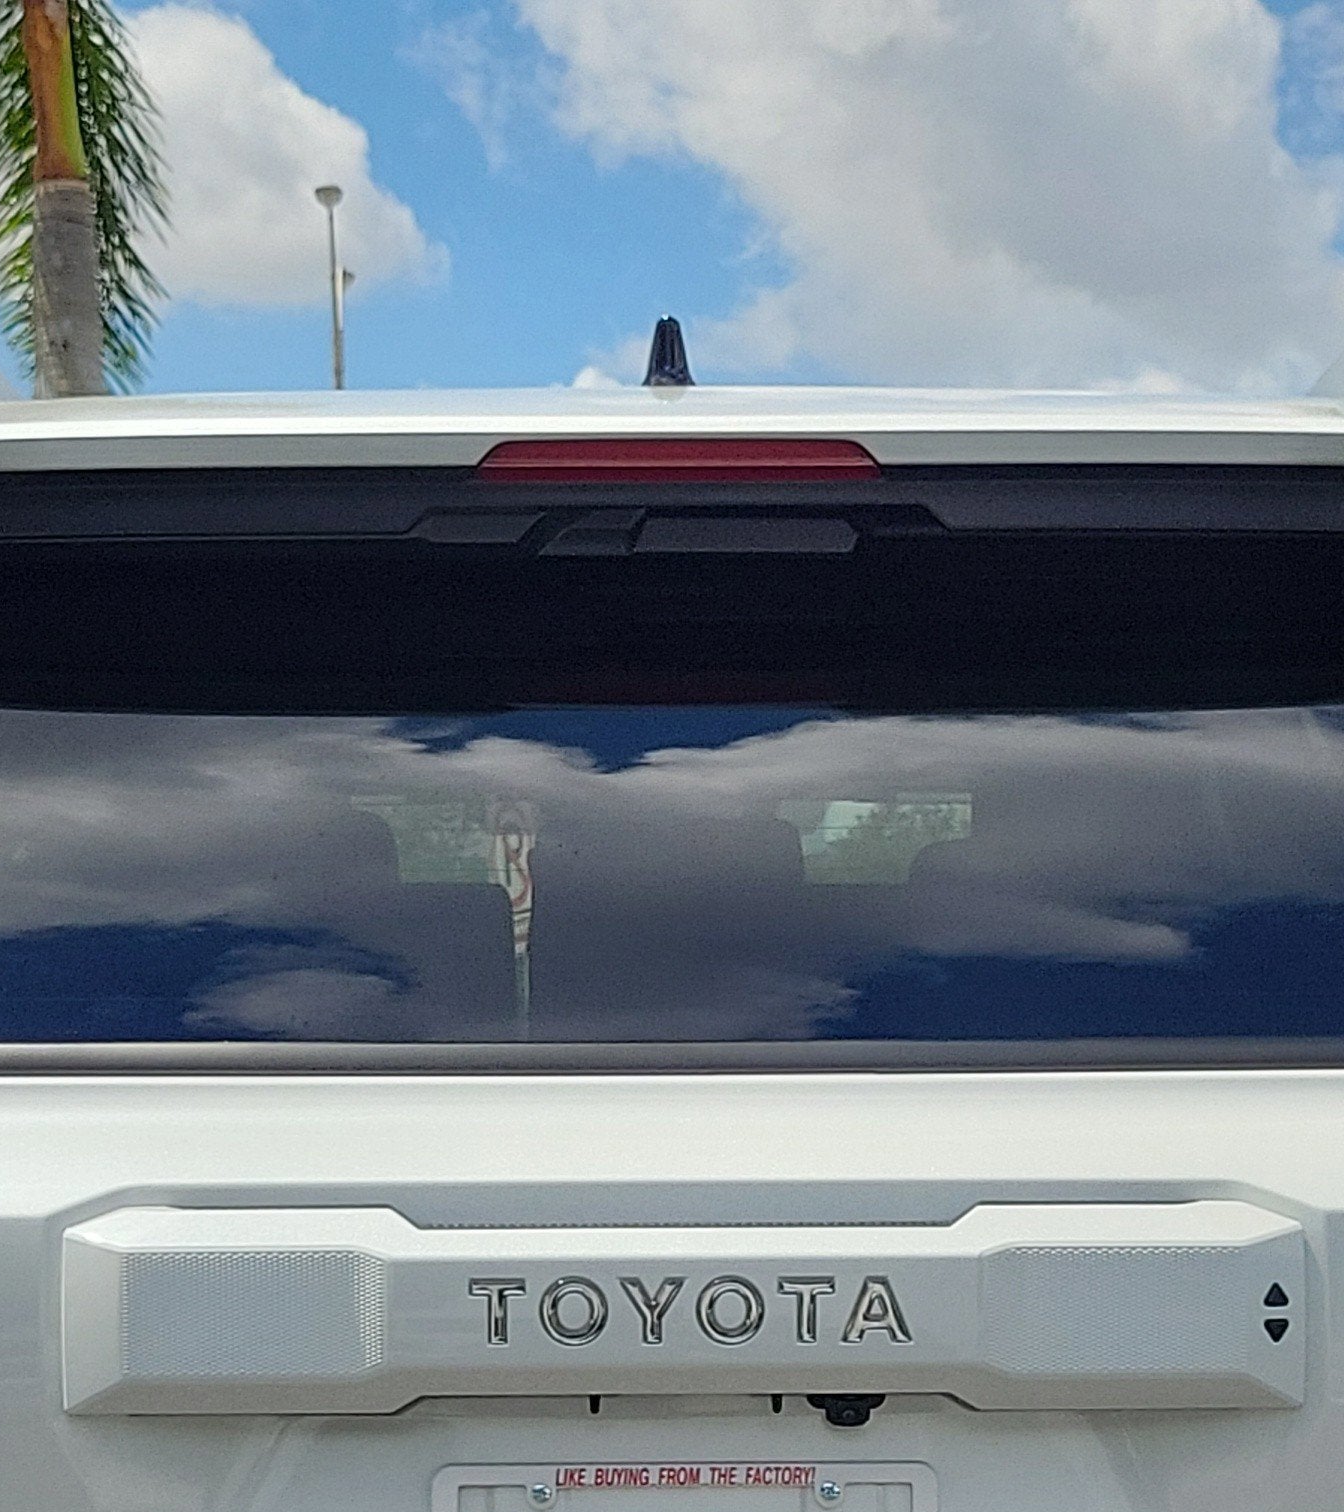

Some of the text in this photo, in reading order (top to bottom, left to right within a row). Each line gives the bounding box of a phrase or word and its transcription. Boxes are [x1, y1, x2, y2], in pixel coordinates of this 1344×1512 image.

[468, 1275, 914, 1346] TOYOTA
[556, 1466, 816, 1486] LIKE BUYING FROM THE FACTORY!
